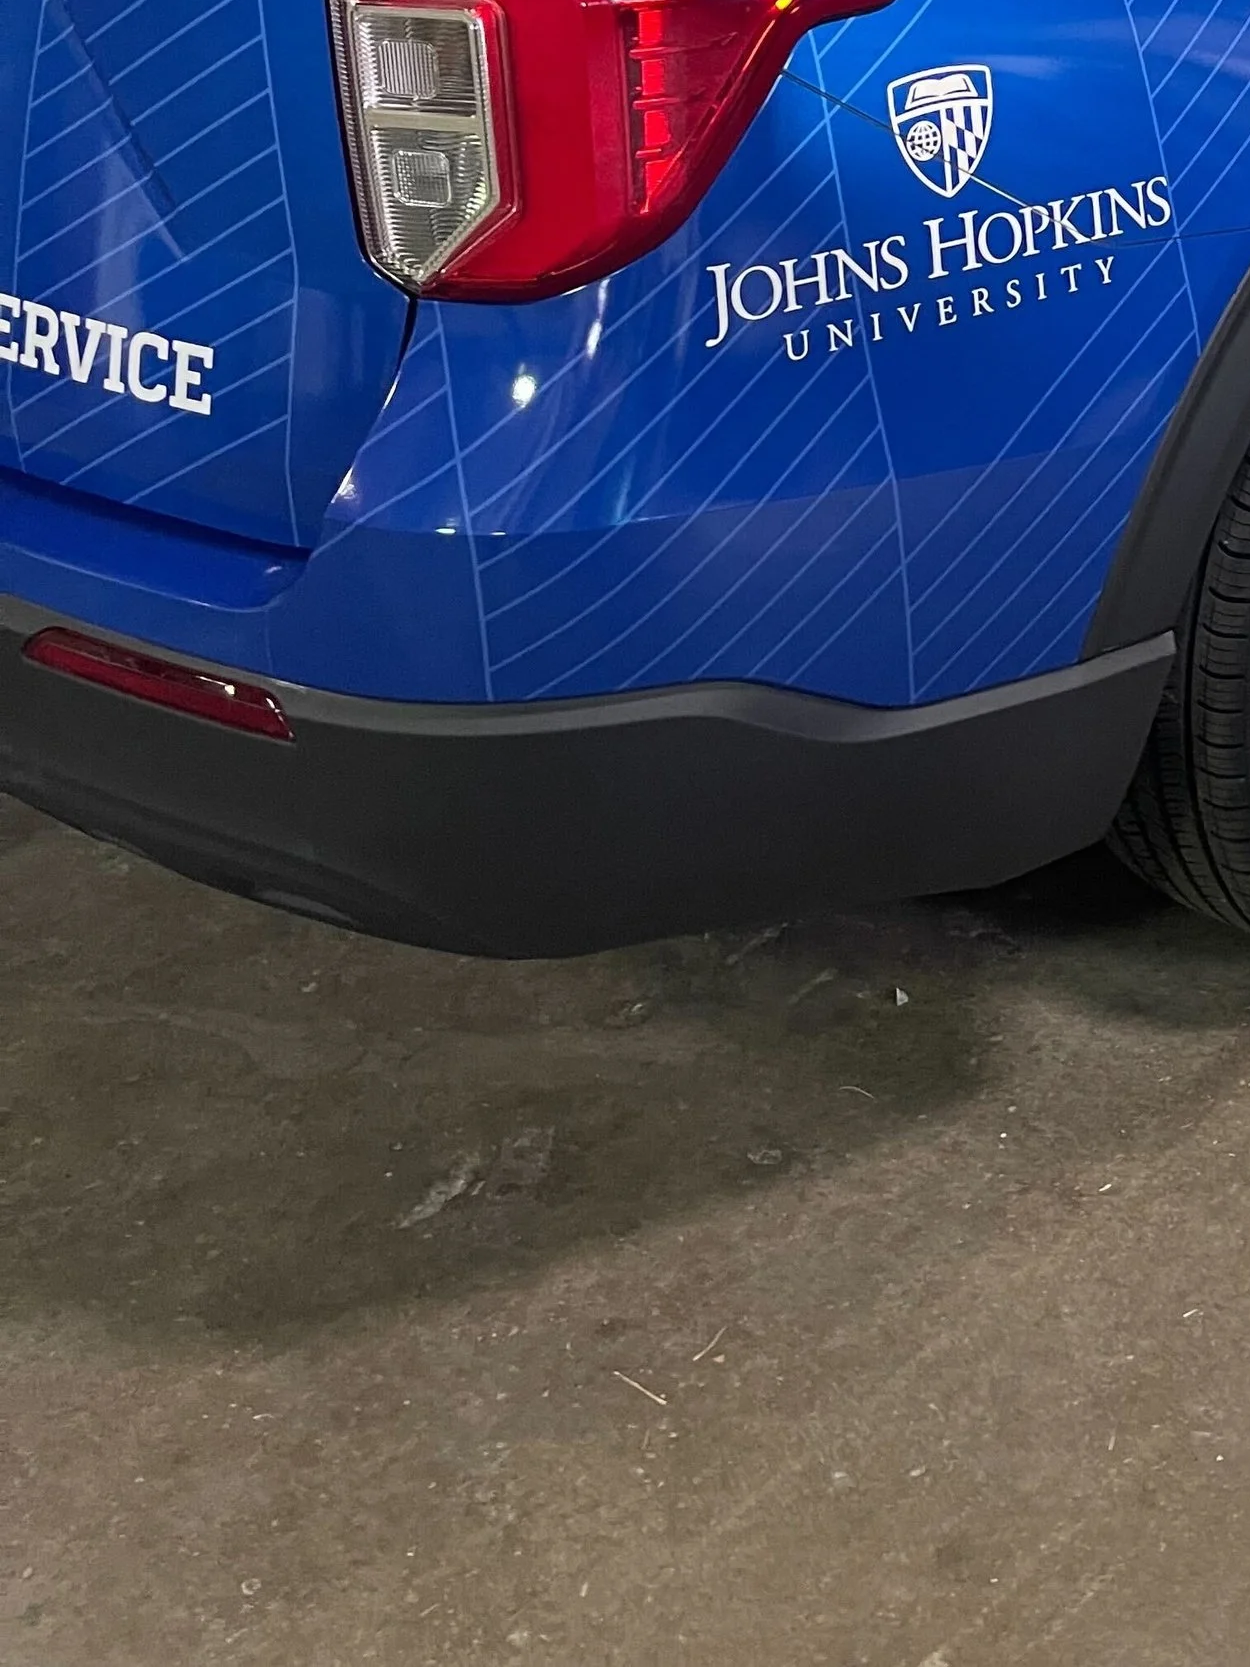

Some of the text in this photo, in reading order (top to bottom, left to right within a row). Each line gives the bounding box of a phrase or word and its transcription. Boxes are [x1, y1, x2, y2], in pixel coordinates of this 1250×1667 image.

[705, 176, 1172, 348] JOHNS HOPKINS
[783, 256, 1115, 362] UNIVERSITY
